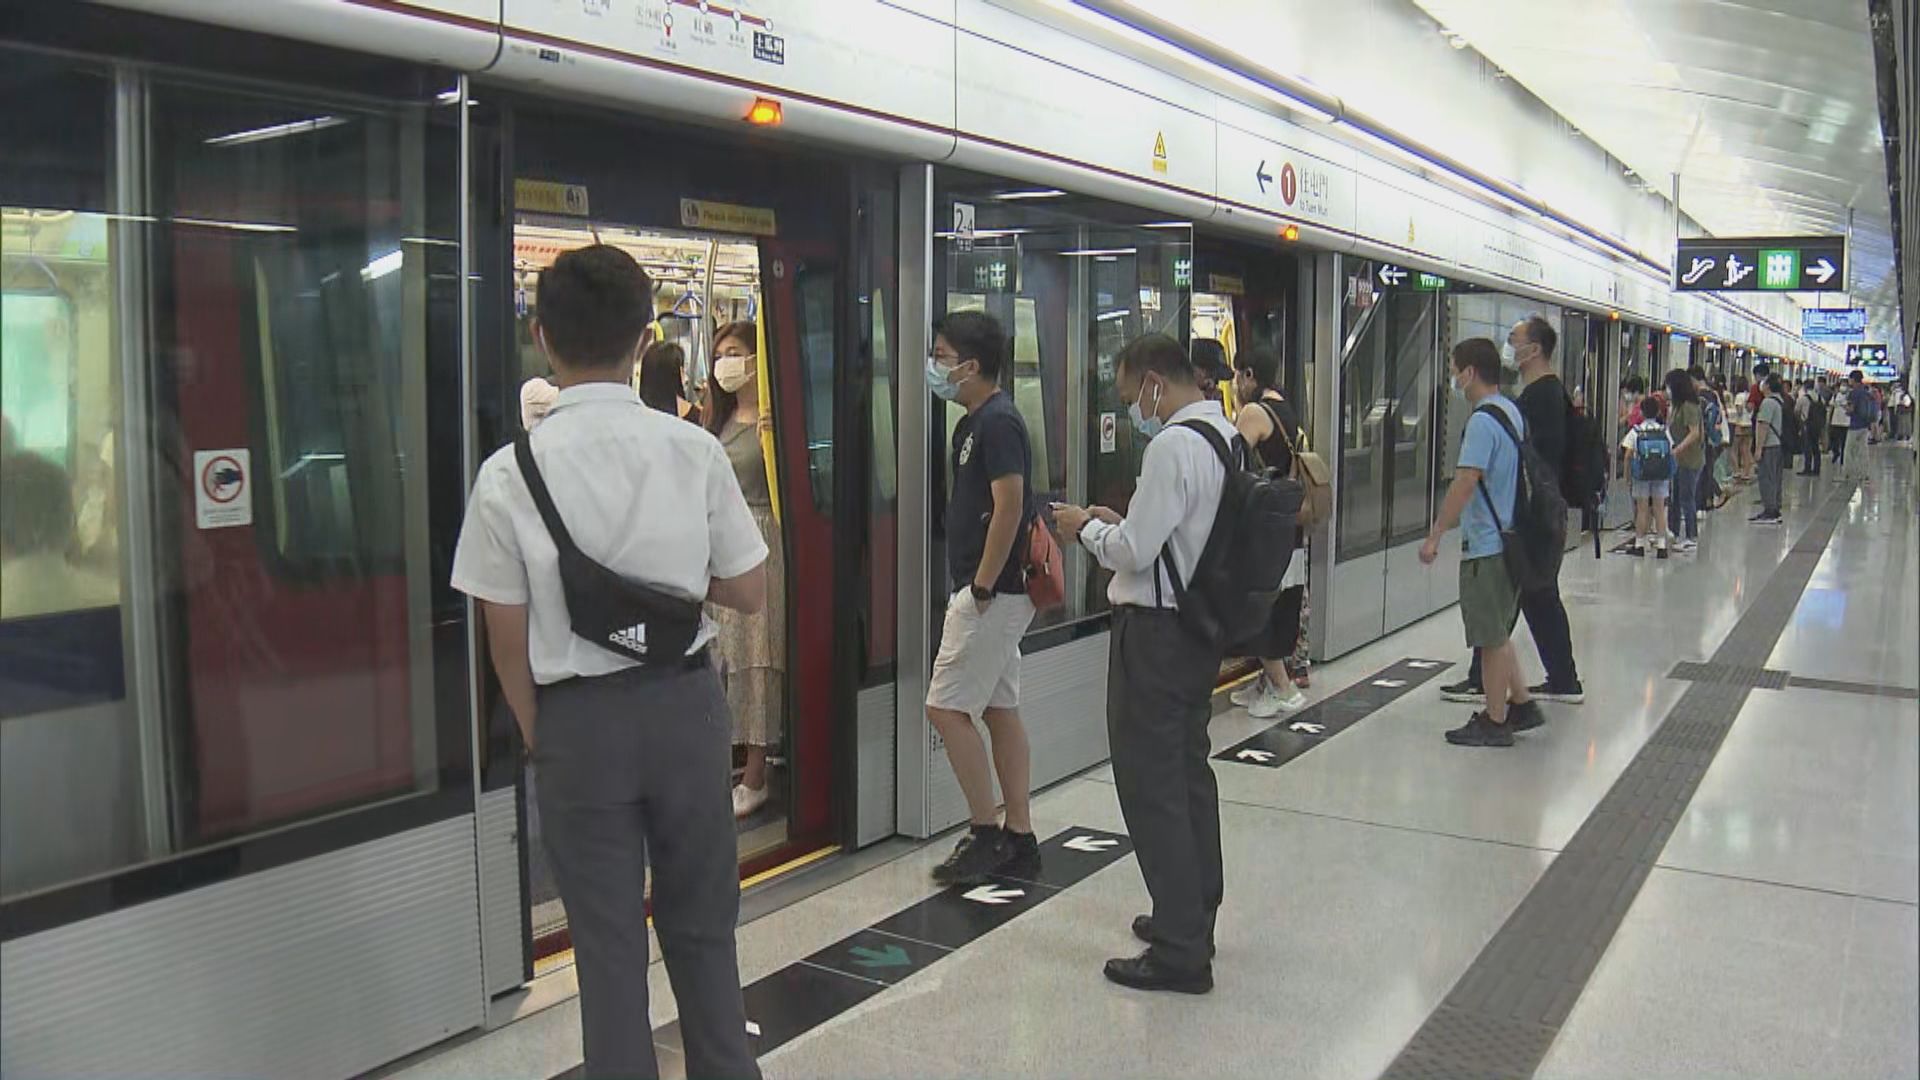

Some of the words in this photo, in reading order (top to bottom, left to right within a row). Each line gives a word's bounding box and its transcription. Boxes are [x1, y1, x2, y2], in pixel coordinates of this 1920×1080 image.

[1300, 167, 1328, 202] 往屯門
[608, 632, 648, 654] adidas
